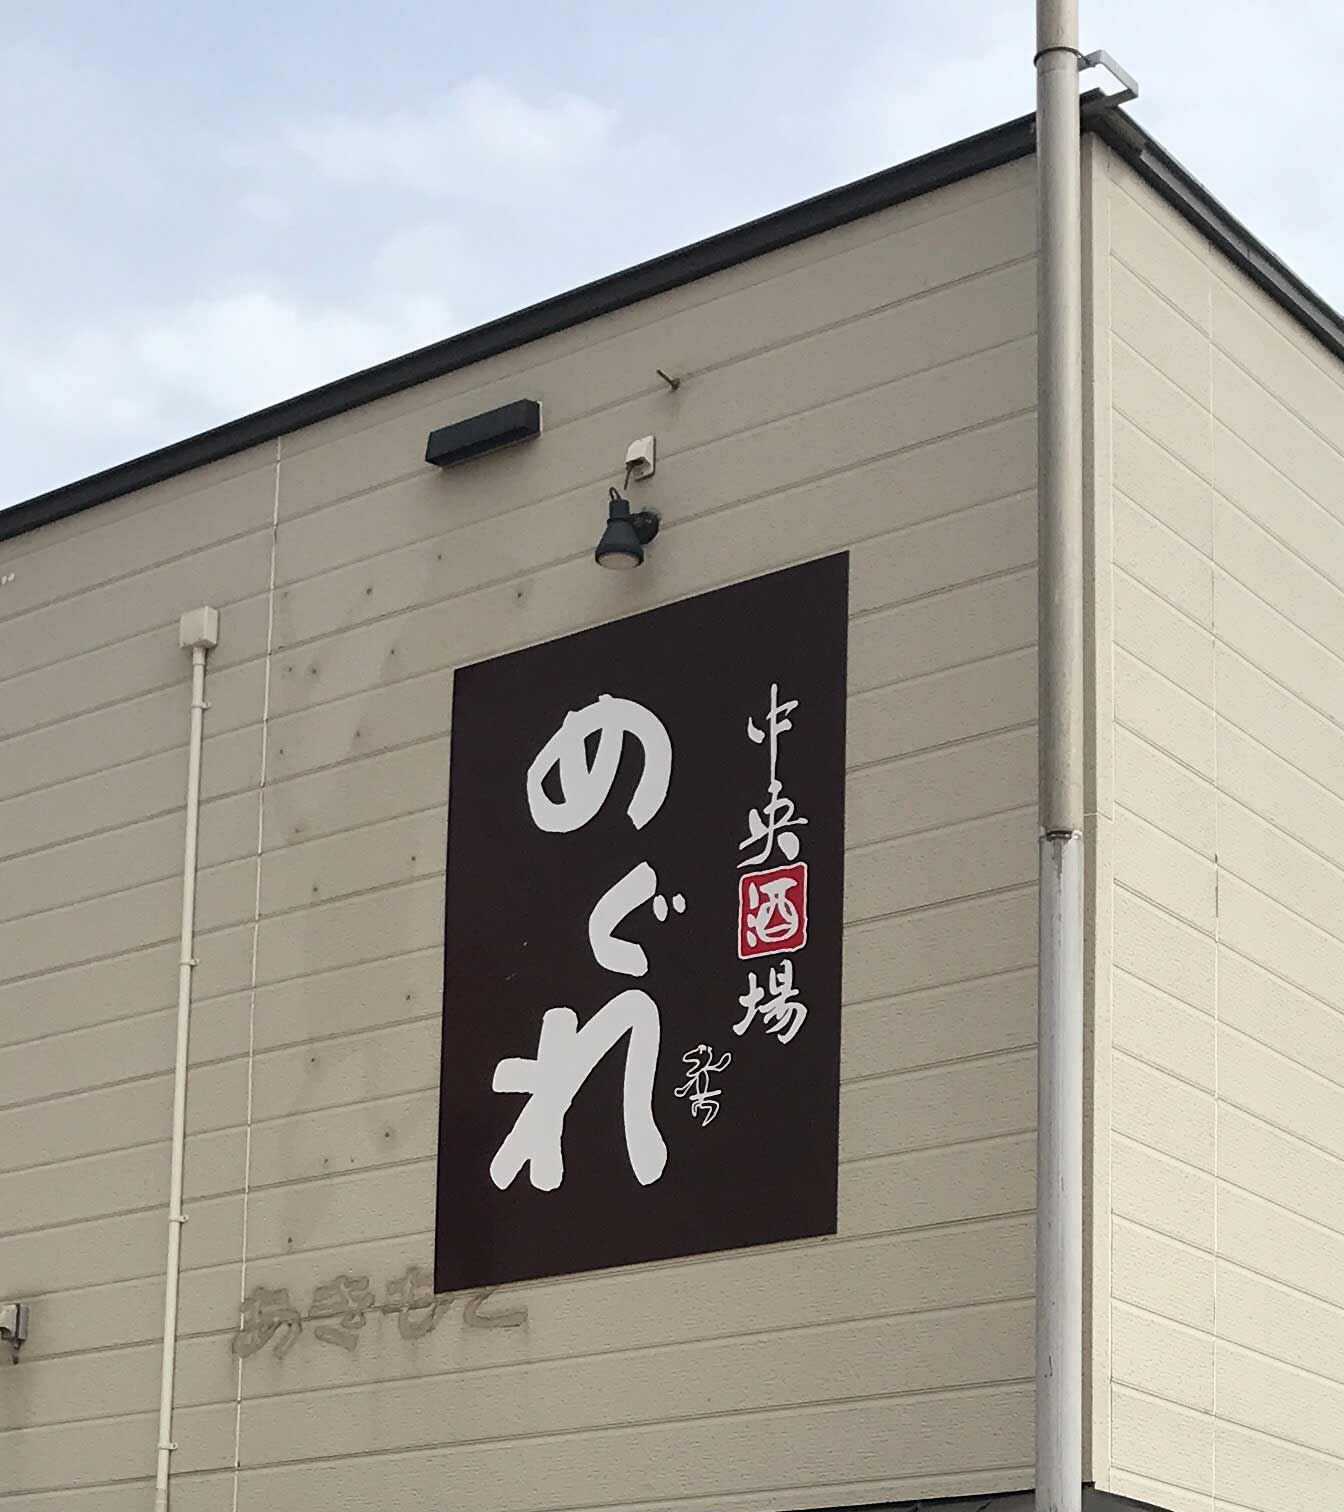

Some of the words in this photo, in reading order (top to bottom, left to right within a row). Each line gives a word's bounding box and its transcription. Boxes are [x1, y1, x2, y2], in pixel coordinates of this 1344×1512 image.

[489, 693, 686, 1192] めぐれ
[733, 683, 809, 1045] 中央酒場
